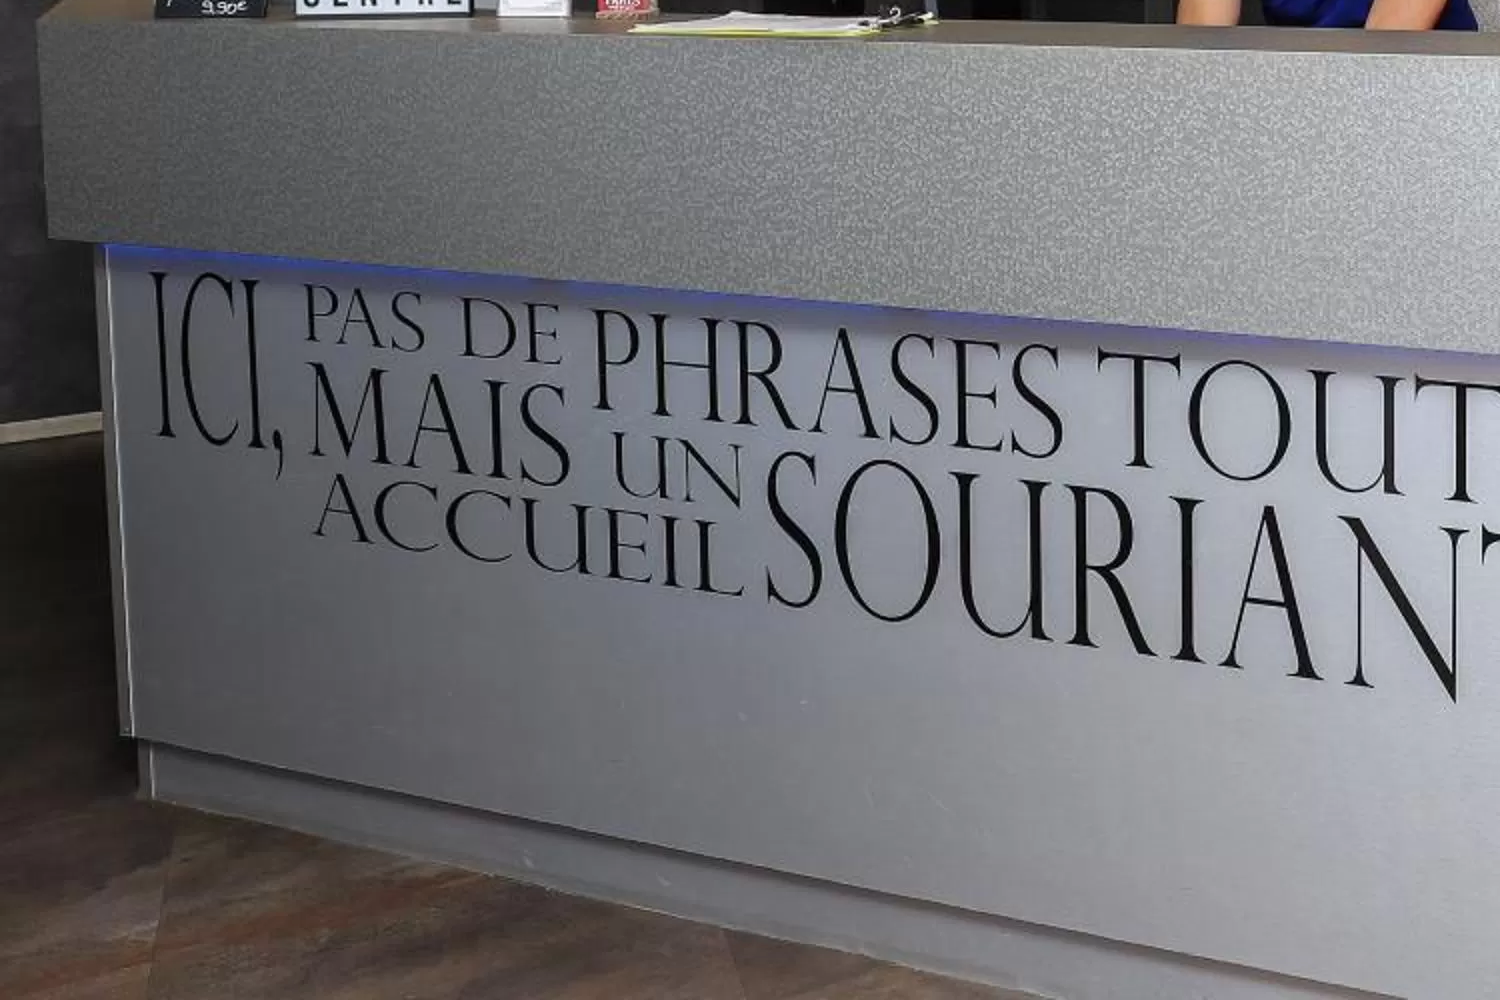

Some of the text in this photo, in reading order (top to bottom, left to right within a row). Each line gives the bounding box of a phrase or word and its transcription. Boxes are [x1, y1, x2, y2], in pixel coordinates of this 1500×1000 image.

[149, 271, 285, 480] ICI,
[303, 283, 425, 353] PAS
[458, 297, 563, 365] DE
[592, 309, 1064, 460] PHRASES
[306, 361, 742, 509] MAIS UN
[313, 472, 744, 597] ACCUEIL
